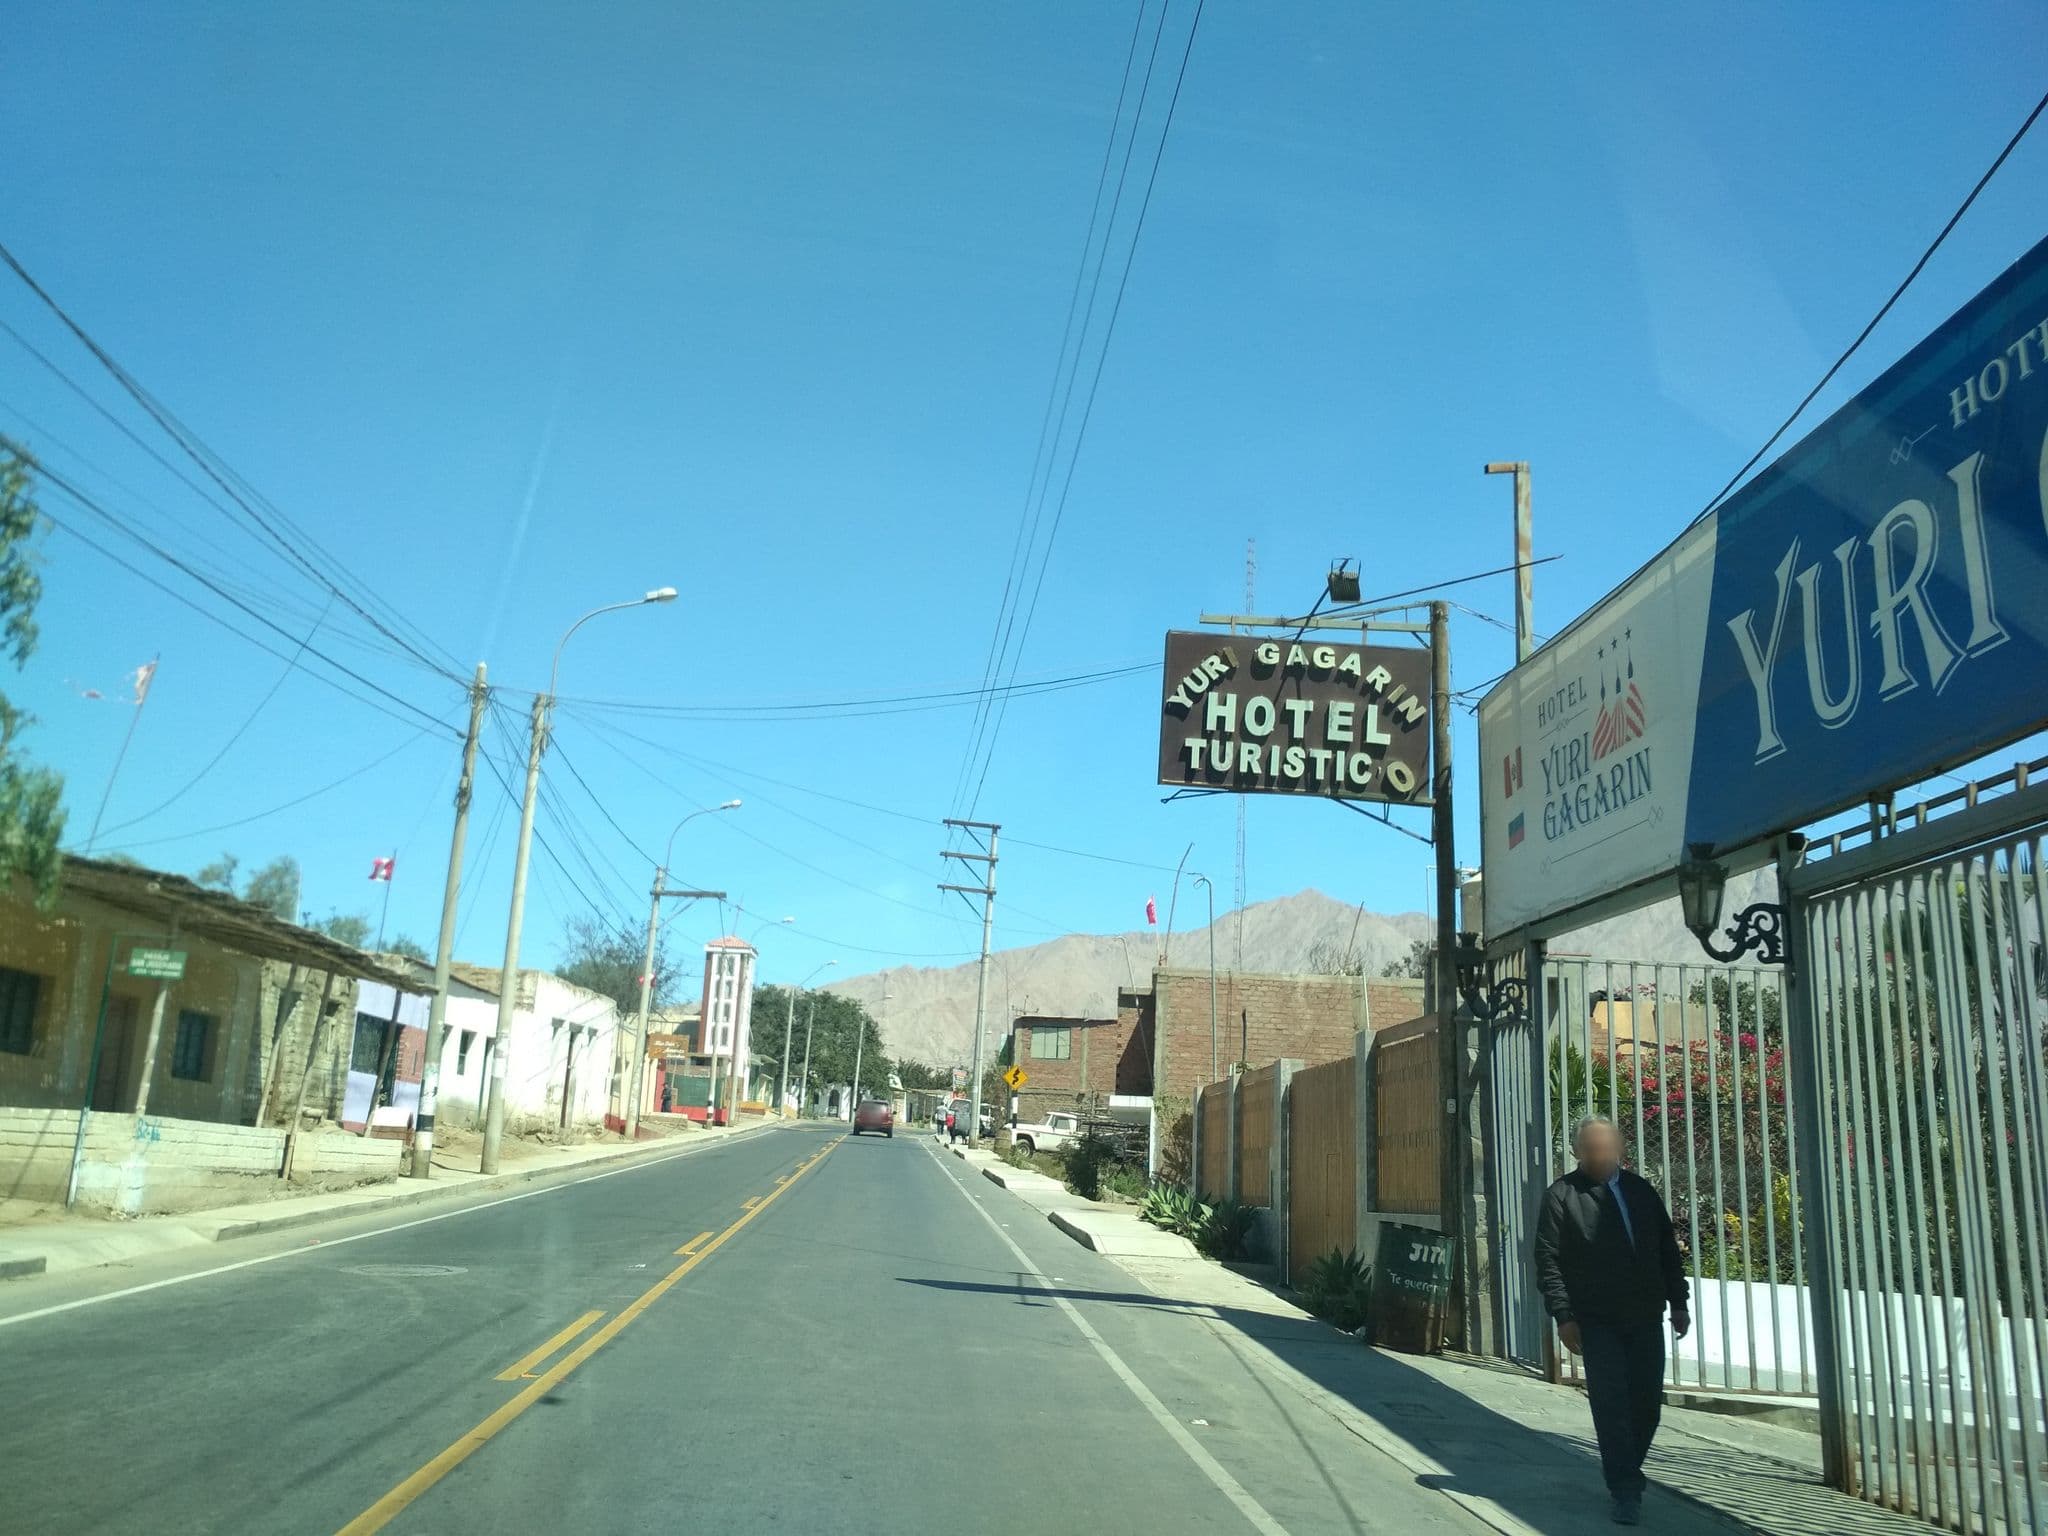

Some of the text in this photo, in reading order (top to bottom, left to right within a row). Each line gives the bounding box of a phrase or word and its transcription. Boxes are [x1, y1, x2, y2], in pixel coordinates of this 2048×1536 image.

[1727, 451, 2010, 765] YURI
[1166, 642, 1426, 724] YURI GAGARIN
[1538, 676, 1587, 729] HOTEL
[1206, 691, 1391, 746] HOTEL
[1184, 738, 1415, 793] TURISTICO
[1541, 731, 1590, 796] YURI
[1543, 747, 1653, 842] GAGARIN
